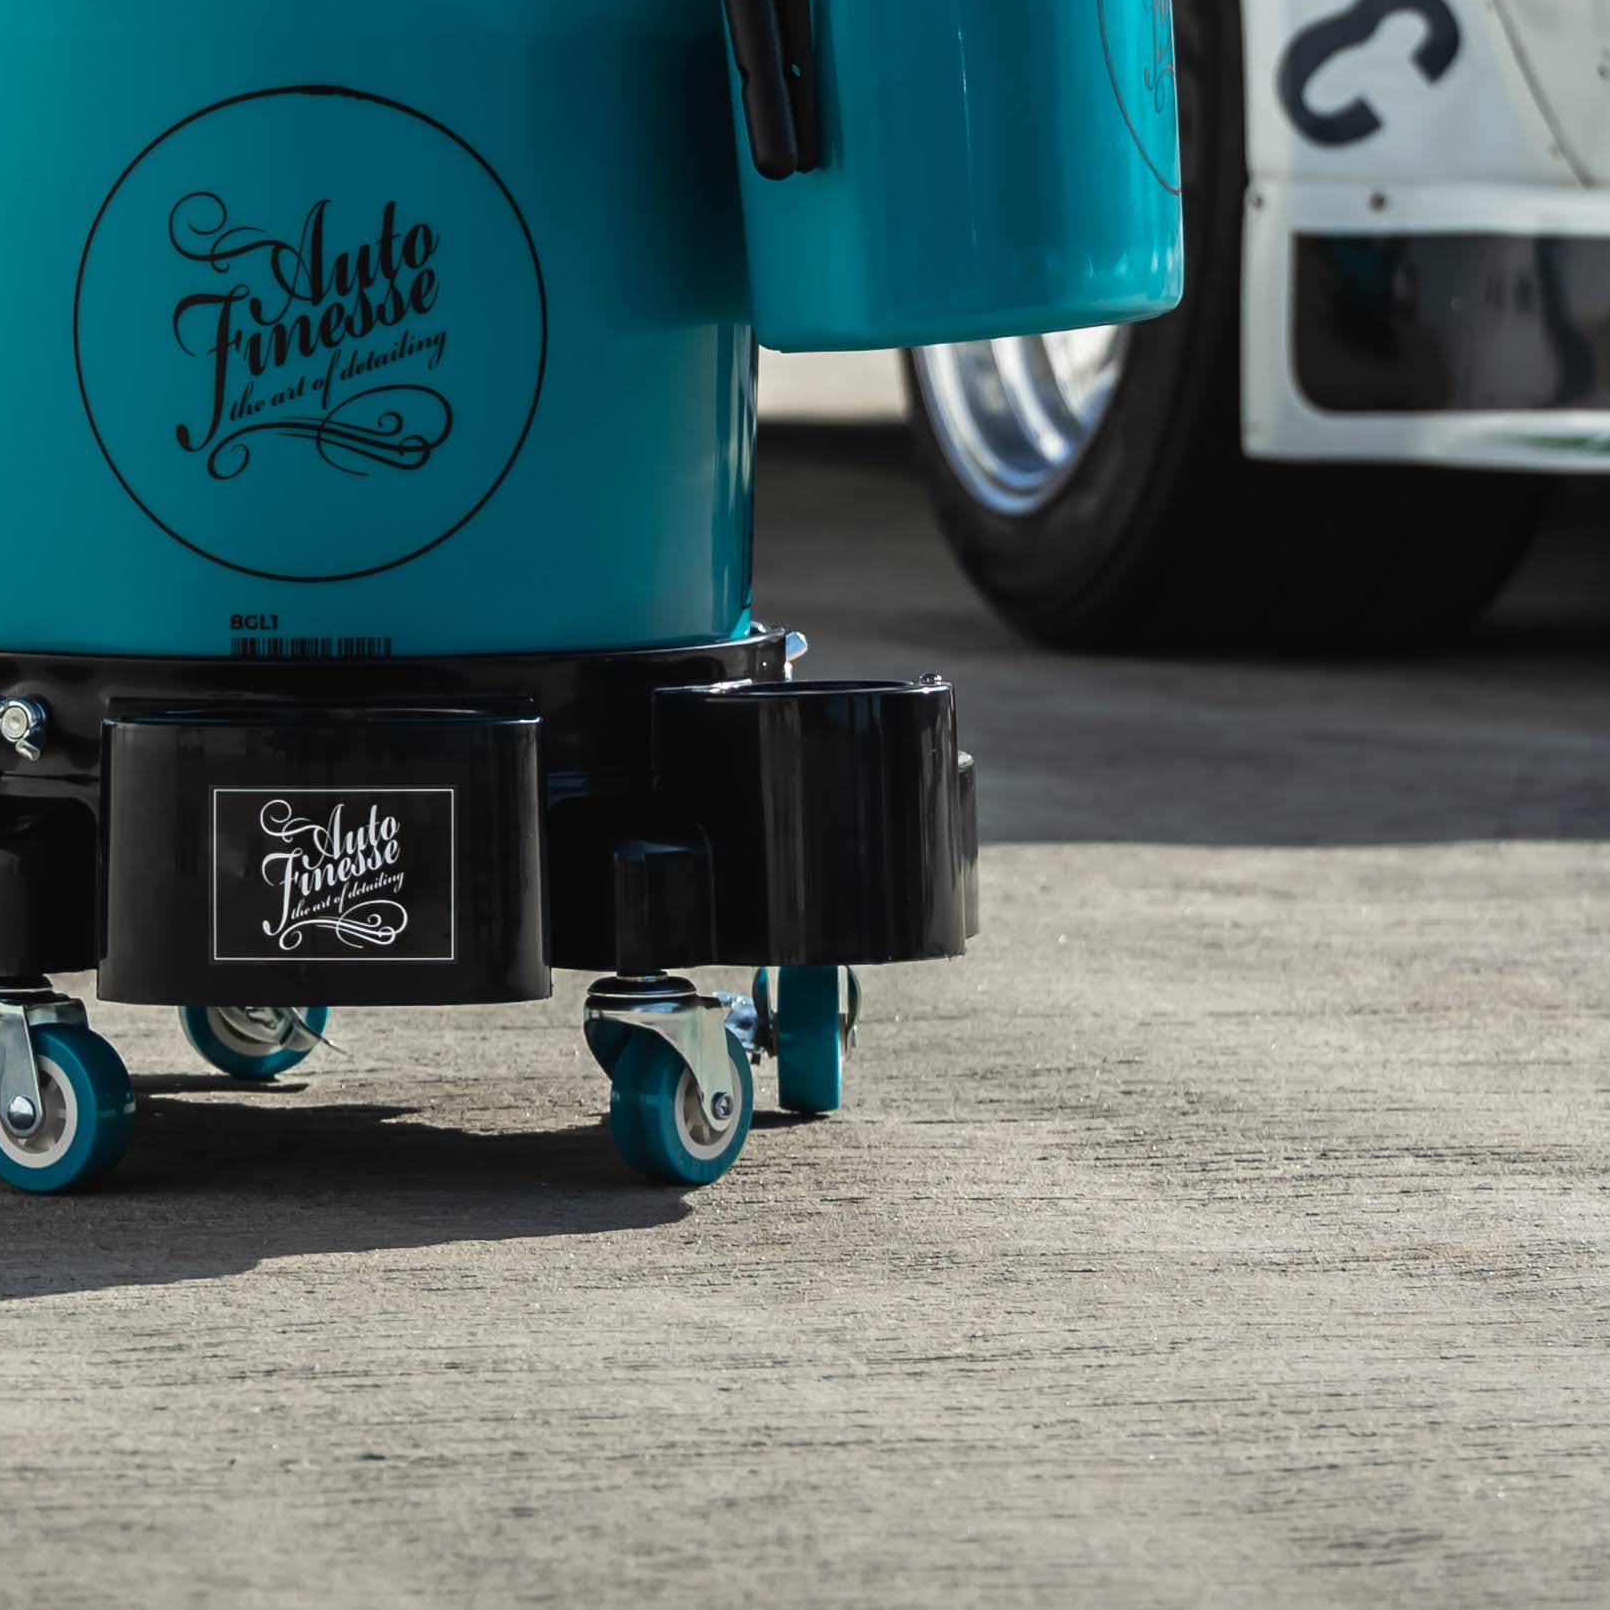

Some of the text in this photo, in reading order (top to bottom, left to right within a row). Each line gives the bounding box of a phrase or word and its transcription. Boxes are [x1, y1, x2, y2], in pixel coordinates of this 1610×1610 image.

[169, 191, 440, 326] Auto
[173, 268, 440, 452] Finesse
[229, 330, 447, 422] the art of detailing
[230, 614, 279, 631] BGL1
[260, 799, 400, 870] Auto
[262, 839, 401, 936] Finesse
[291, 870, 405, 920] the art of detailing
